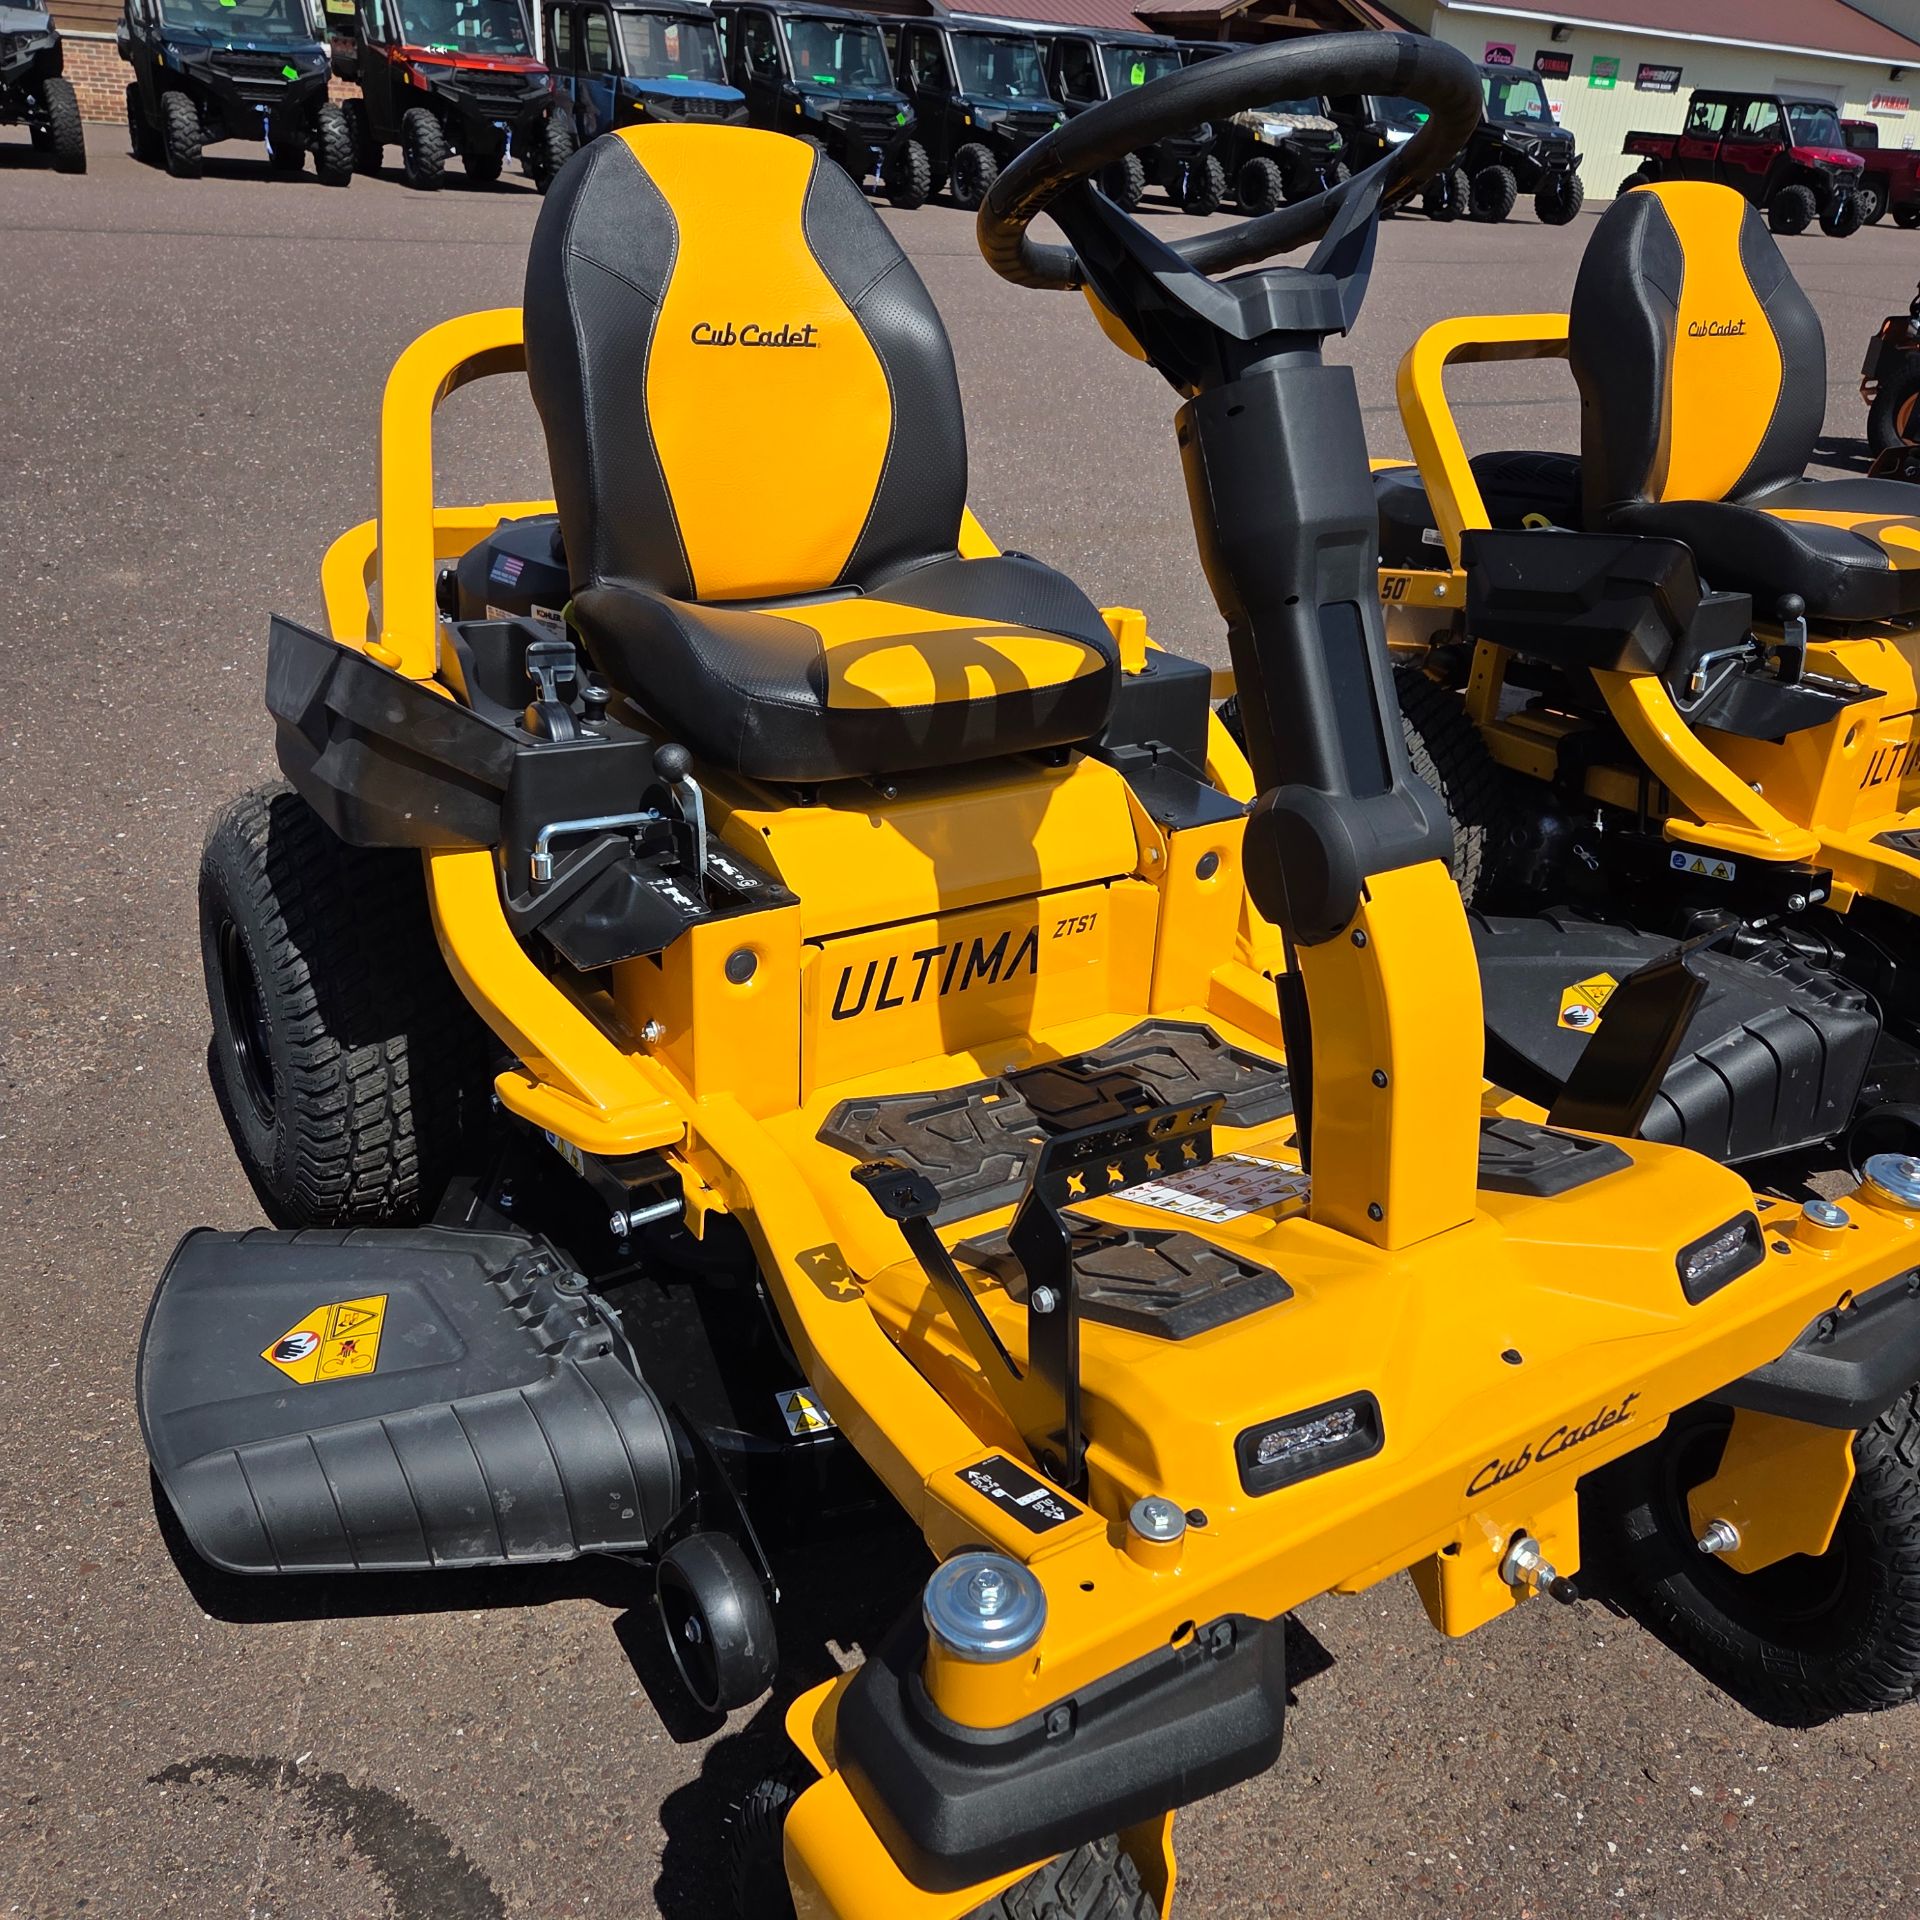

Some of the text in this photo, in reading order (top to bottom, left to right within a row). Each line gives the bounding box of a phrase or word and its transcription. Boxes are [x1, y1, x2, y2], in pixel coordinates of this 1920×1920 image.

[1881, 94, 1910, 111] YAMAHA
[691, 322, 819, 348] Cub Cadet
[1688, 319, 1747, 337] Cub Cadet
[1053, 912, 1098, 939] ZTS1
[831, 925, 1039, 1021] ULTIMA
[1465, 1391, 1641, 1497] Cub Cadet
